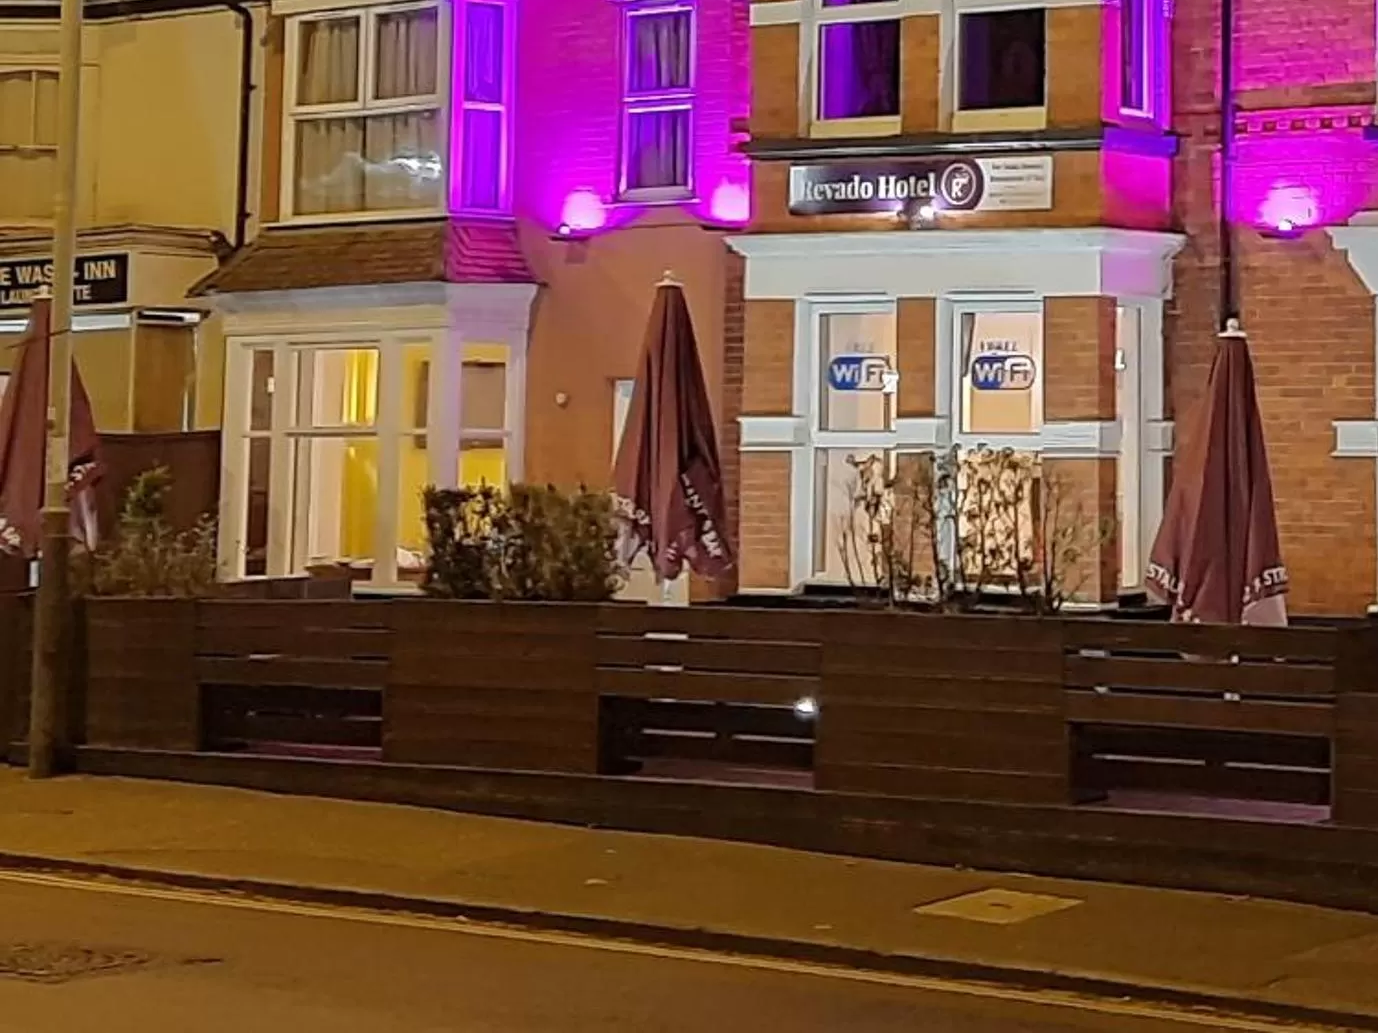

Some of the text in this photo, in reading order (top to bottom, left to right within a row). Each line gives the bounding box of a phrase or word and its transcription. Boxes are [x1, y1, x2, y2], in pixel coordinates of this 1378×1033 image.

[877, 171, 935, 199] Hotel
[15, 264, 54, 285] WAS
[83, 259, 117, 280] INN
